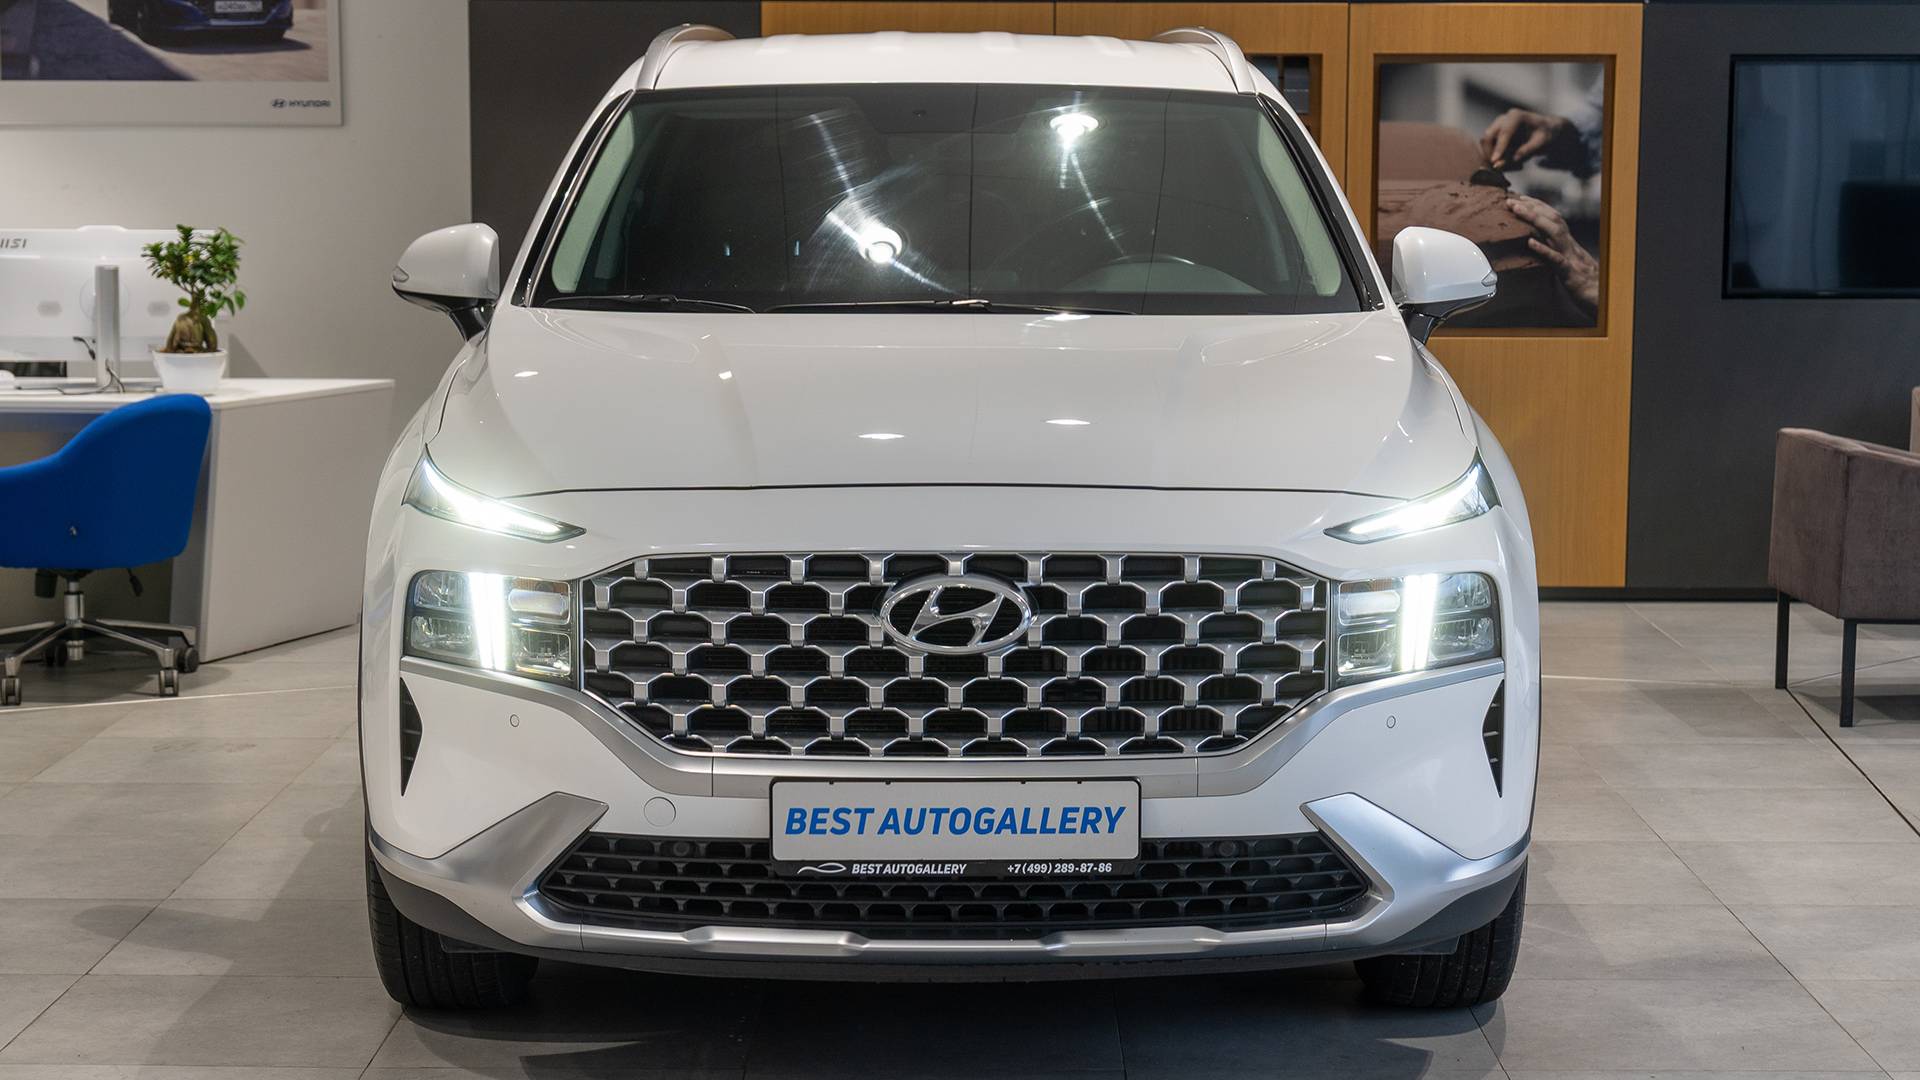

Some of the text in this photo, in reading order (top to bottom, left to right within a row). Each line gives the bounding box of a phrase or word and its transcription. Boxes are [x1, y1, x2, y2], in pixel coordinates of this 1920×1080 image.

[288, 99, 331, 108] HYUNDAI
[785, 806, 1127, 836] BEST AUTOGALLERY
[851, 863, 968, 875] BEST AUTOGALLERY
[1053, 862, 1113, 874] 289-87-86
